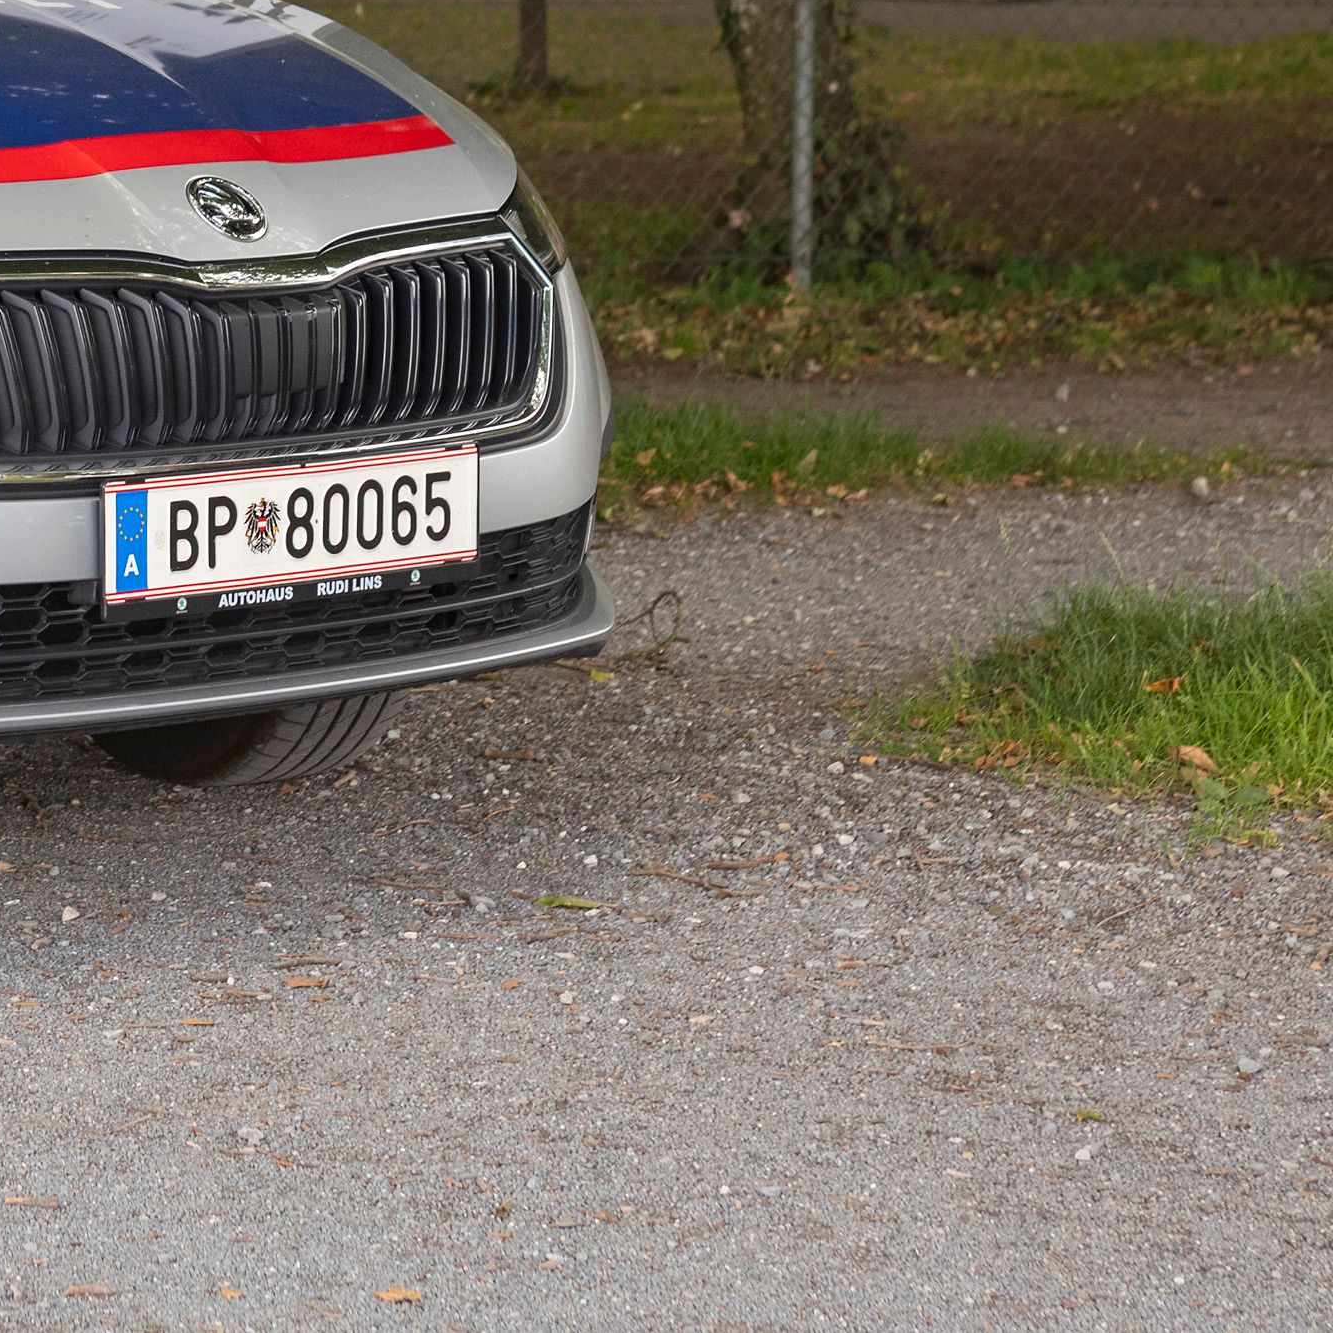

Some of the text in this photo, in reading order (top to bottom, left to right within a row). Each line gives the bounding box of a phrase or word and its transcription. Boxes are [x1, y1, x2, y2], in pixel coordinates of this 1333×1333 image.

[170, 471, 452, 572] BP 80065
[123, 554, 139, 577] A
[218, 575, 383, 608] AUTOHAUS RUDI LINS
